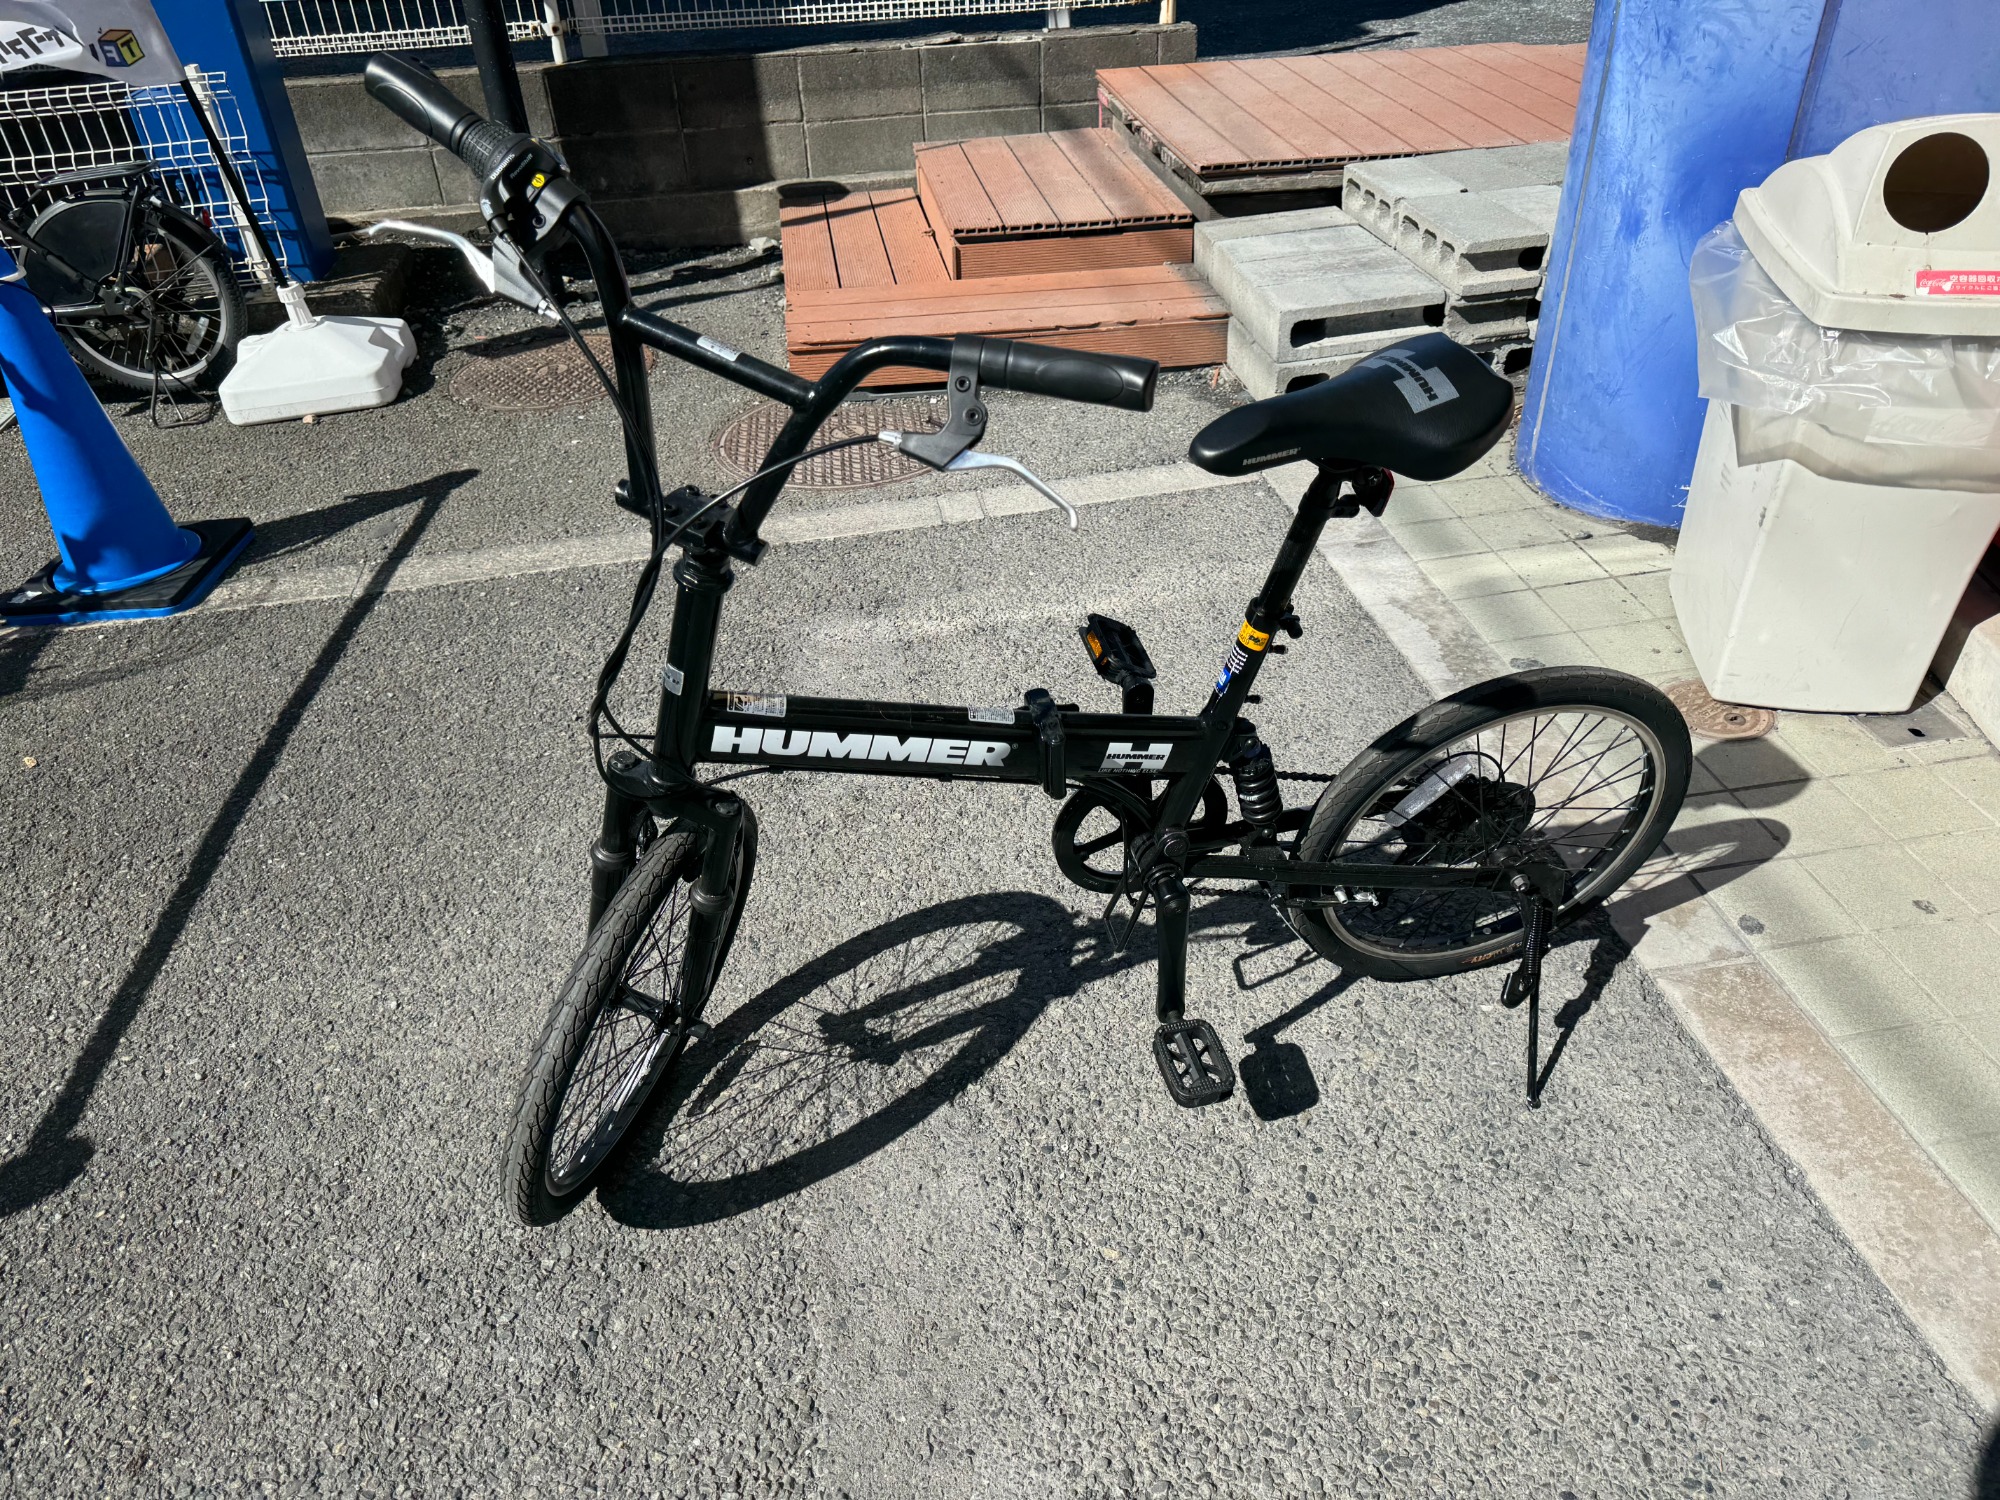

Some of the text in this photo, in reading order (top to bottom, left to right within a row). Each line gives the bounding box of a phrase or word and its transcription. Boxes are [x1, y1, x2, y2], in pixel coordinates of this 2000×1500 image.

[490, 153, 515, 180] SHIMANO
[1242, 448, 1298, 466] HUMMER
[1106, 753, 1166, 761] HUMMER
